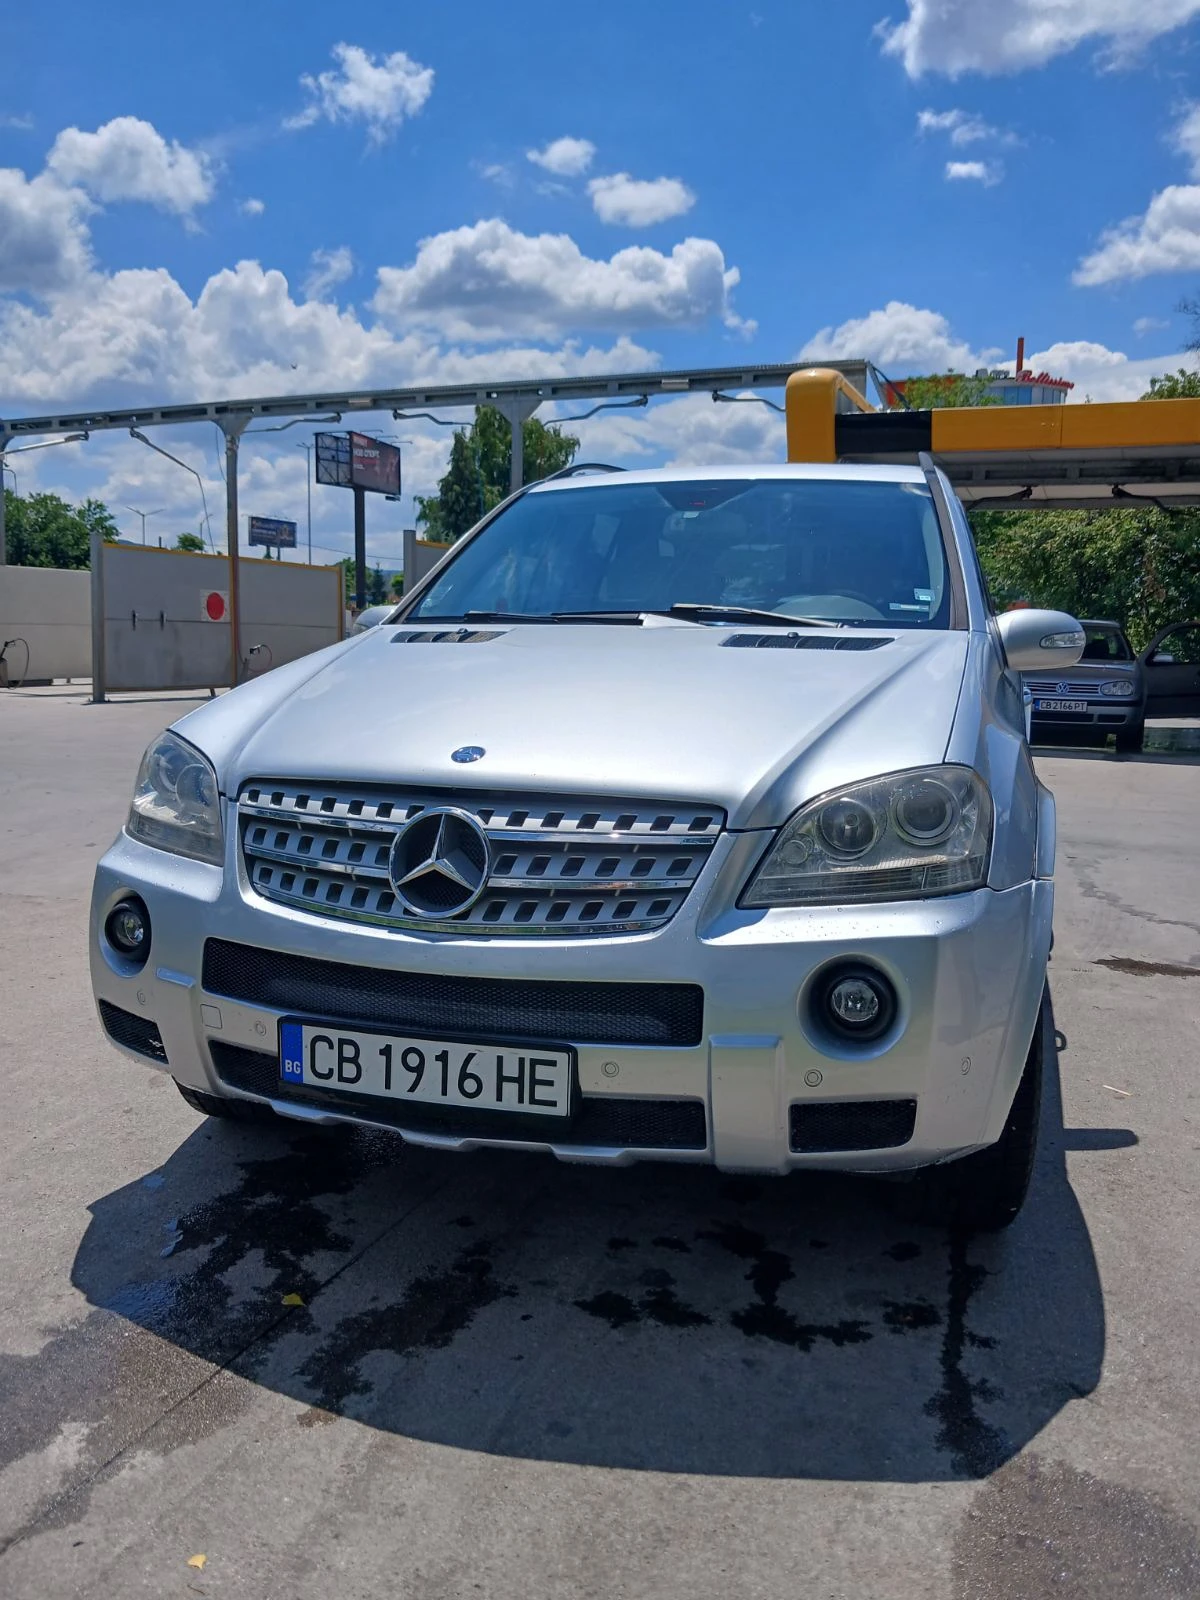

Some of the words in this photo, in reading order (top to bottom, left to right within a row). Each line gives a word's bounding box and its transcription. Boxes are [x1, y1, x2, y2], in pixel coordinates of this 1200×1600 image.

[1041, 701, 1052, 710] CB
[1053, 701, 1073, 710] 2166
[1075, 702, 1086, 711] PT
[284, 1060, 301, 1074] BG
[309, 1034, 363, 1084] CB
[378, 1043, 483, 1099] 1916
[496, 1055, 558, 1107] HE
